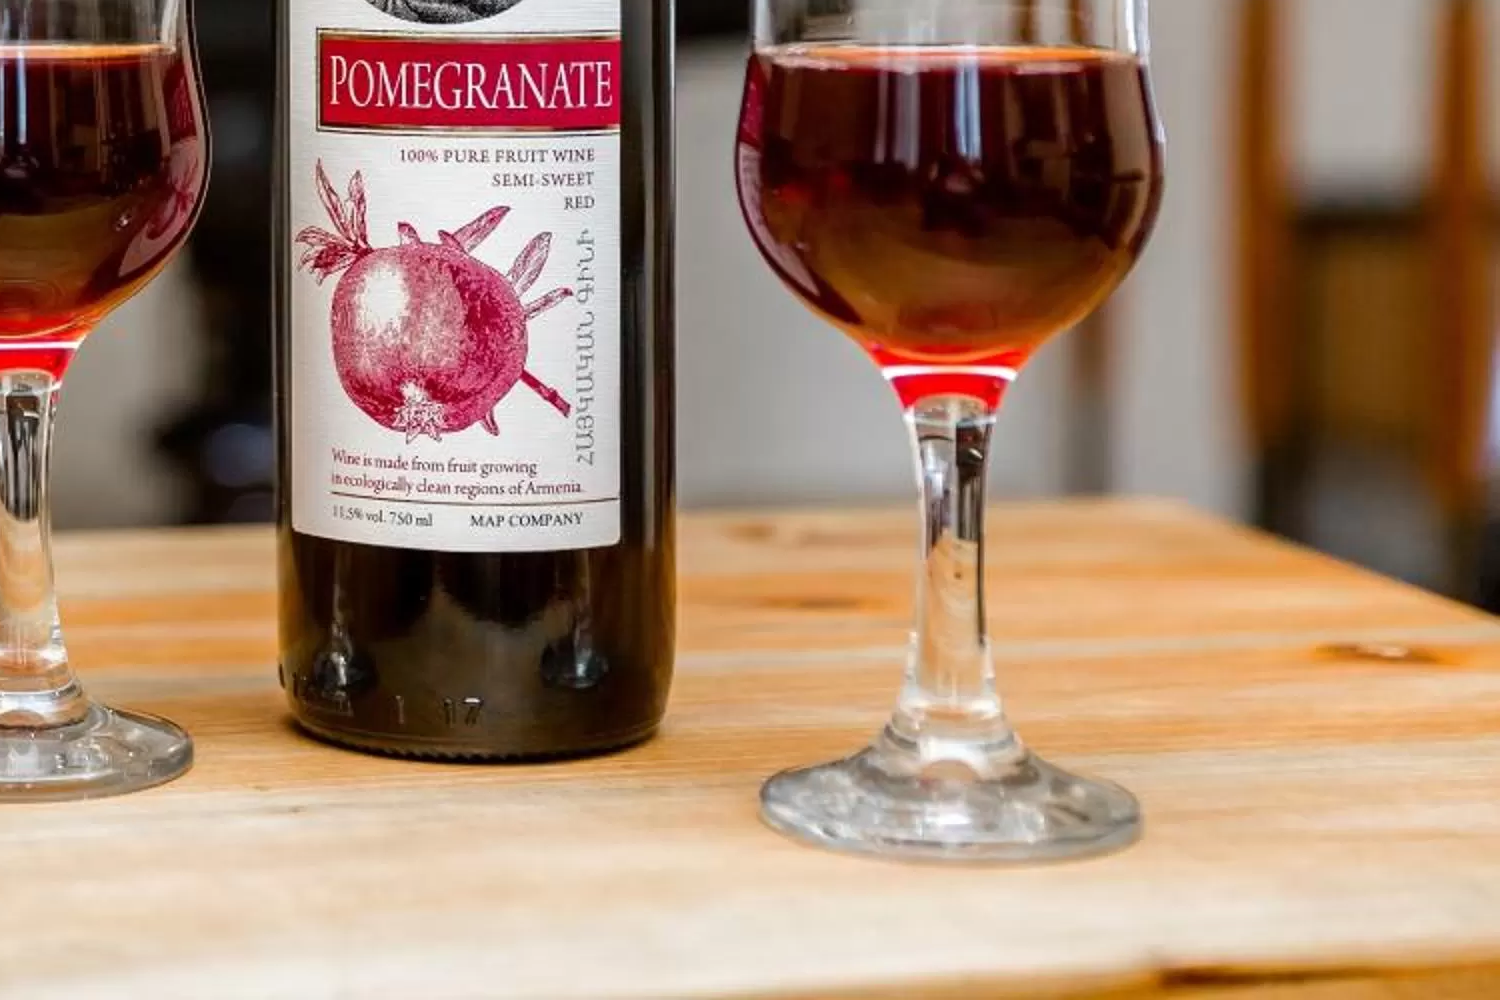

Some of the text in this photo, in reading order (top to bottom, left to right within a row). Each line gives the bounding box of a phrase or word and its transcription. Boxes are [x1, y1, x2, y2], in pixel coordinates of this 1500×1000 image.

[329, 55, 613, 110] POMEGRANATE
[400, 148, 595, 163] 100% PURE FRUIT WINE
[492, 172, 595, 187] SEMI-SWEET
[563, 195, 595, 210] RED
[332, 448, 537, 478] Wine is made from fruit growing
[332, 473, 343, 485] in
[344, 474, 413, 496] ecologically
[416, 478, 451, 494] clean
[455, 482, 505, 500] regions
[508, 480, 525, 495] of
[366, 509, 387, 523] vol.
[389, 511, 413, 526] 750
[415, 513, 433, 526] ml
[470, 512, 583, 527] MAP COMPANY
